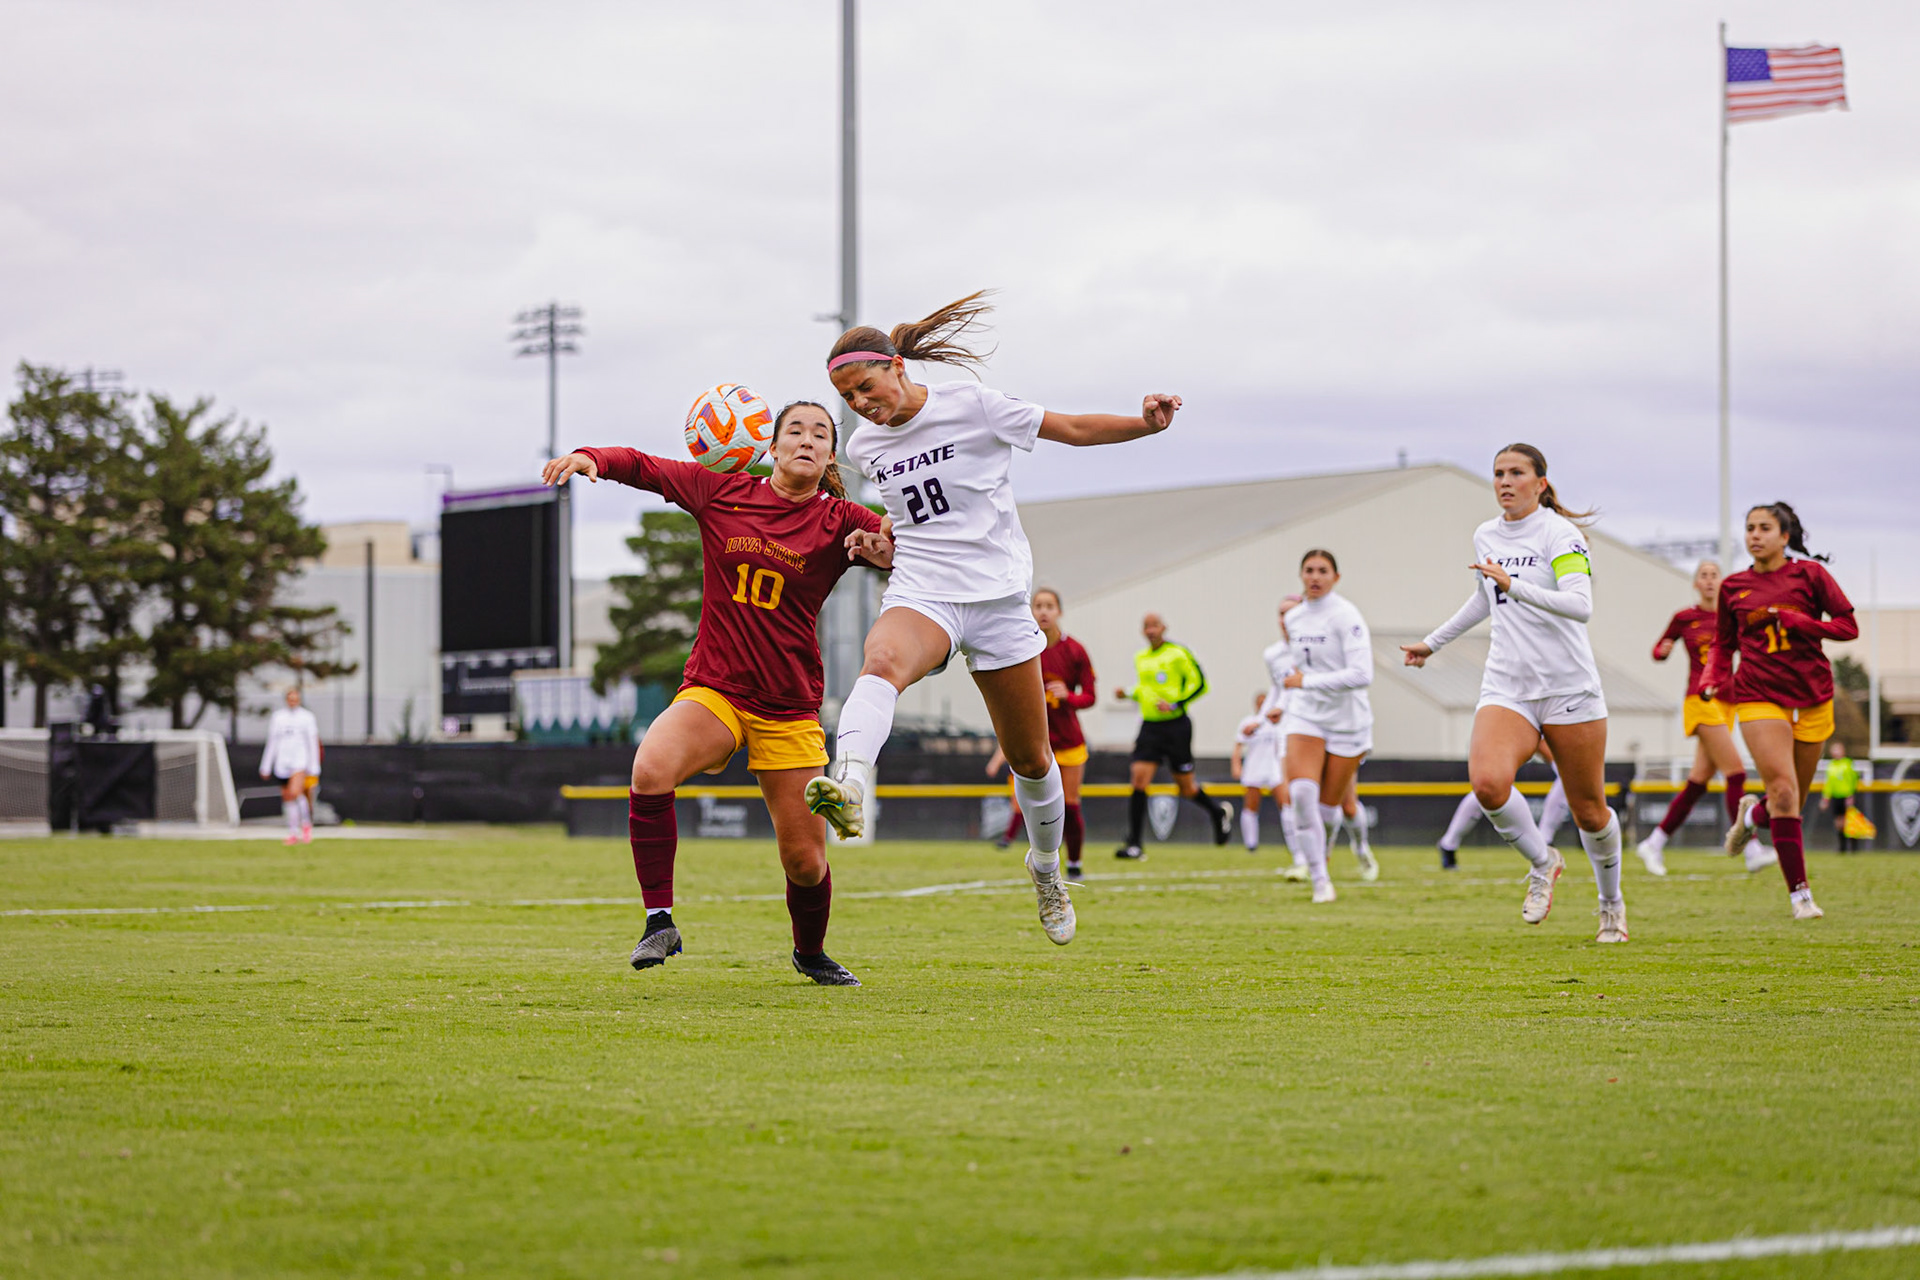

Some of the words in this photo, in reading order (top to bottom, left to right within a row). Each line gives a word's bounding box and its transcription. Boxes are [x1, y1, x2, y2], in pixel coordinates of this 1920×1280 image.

[876, 443, 955, 484] K-STATE
[901, 477, 950, 525] 28
[724, 536, 762, 554] IOWA
[763, 540, 807, 574] STATE
[1497, 556, 1539, 568] STATE
[732, 563, 784, 610] 10
[1764, 624, 1792, 654] 11
